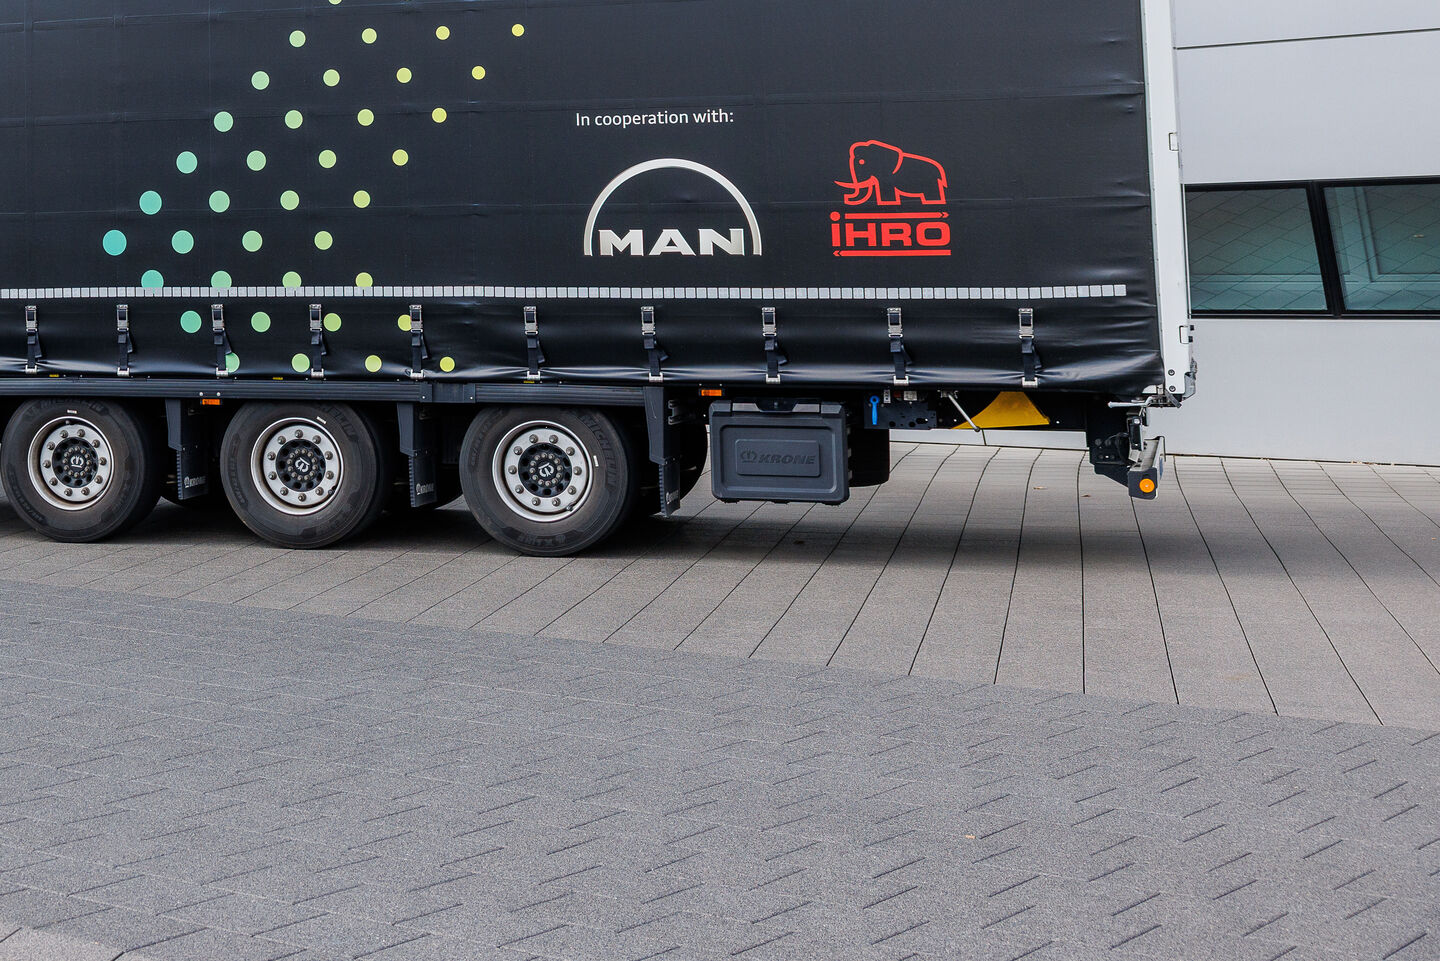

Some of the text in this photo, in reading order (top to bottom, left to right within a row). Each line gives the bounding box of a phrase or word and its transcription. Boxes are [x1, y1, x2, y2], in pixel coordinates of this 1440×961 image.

[576, 109, 734, 129] In cooperation with:
[598, 229, 745, 257] MAN
[759, 453, 817, 465] KRONE
